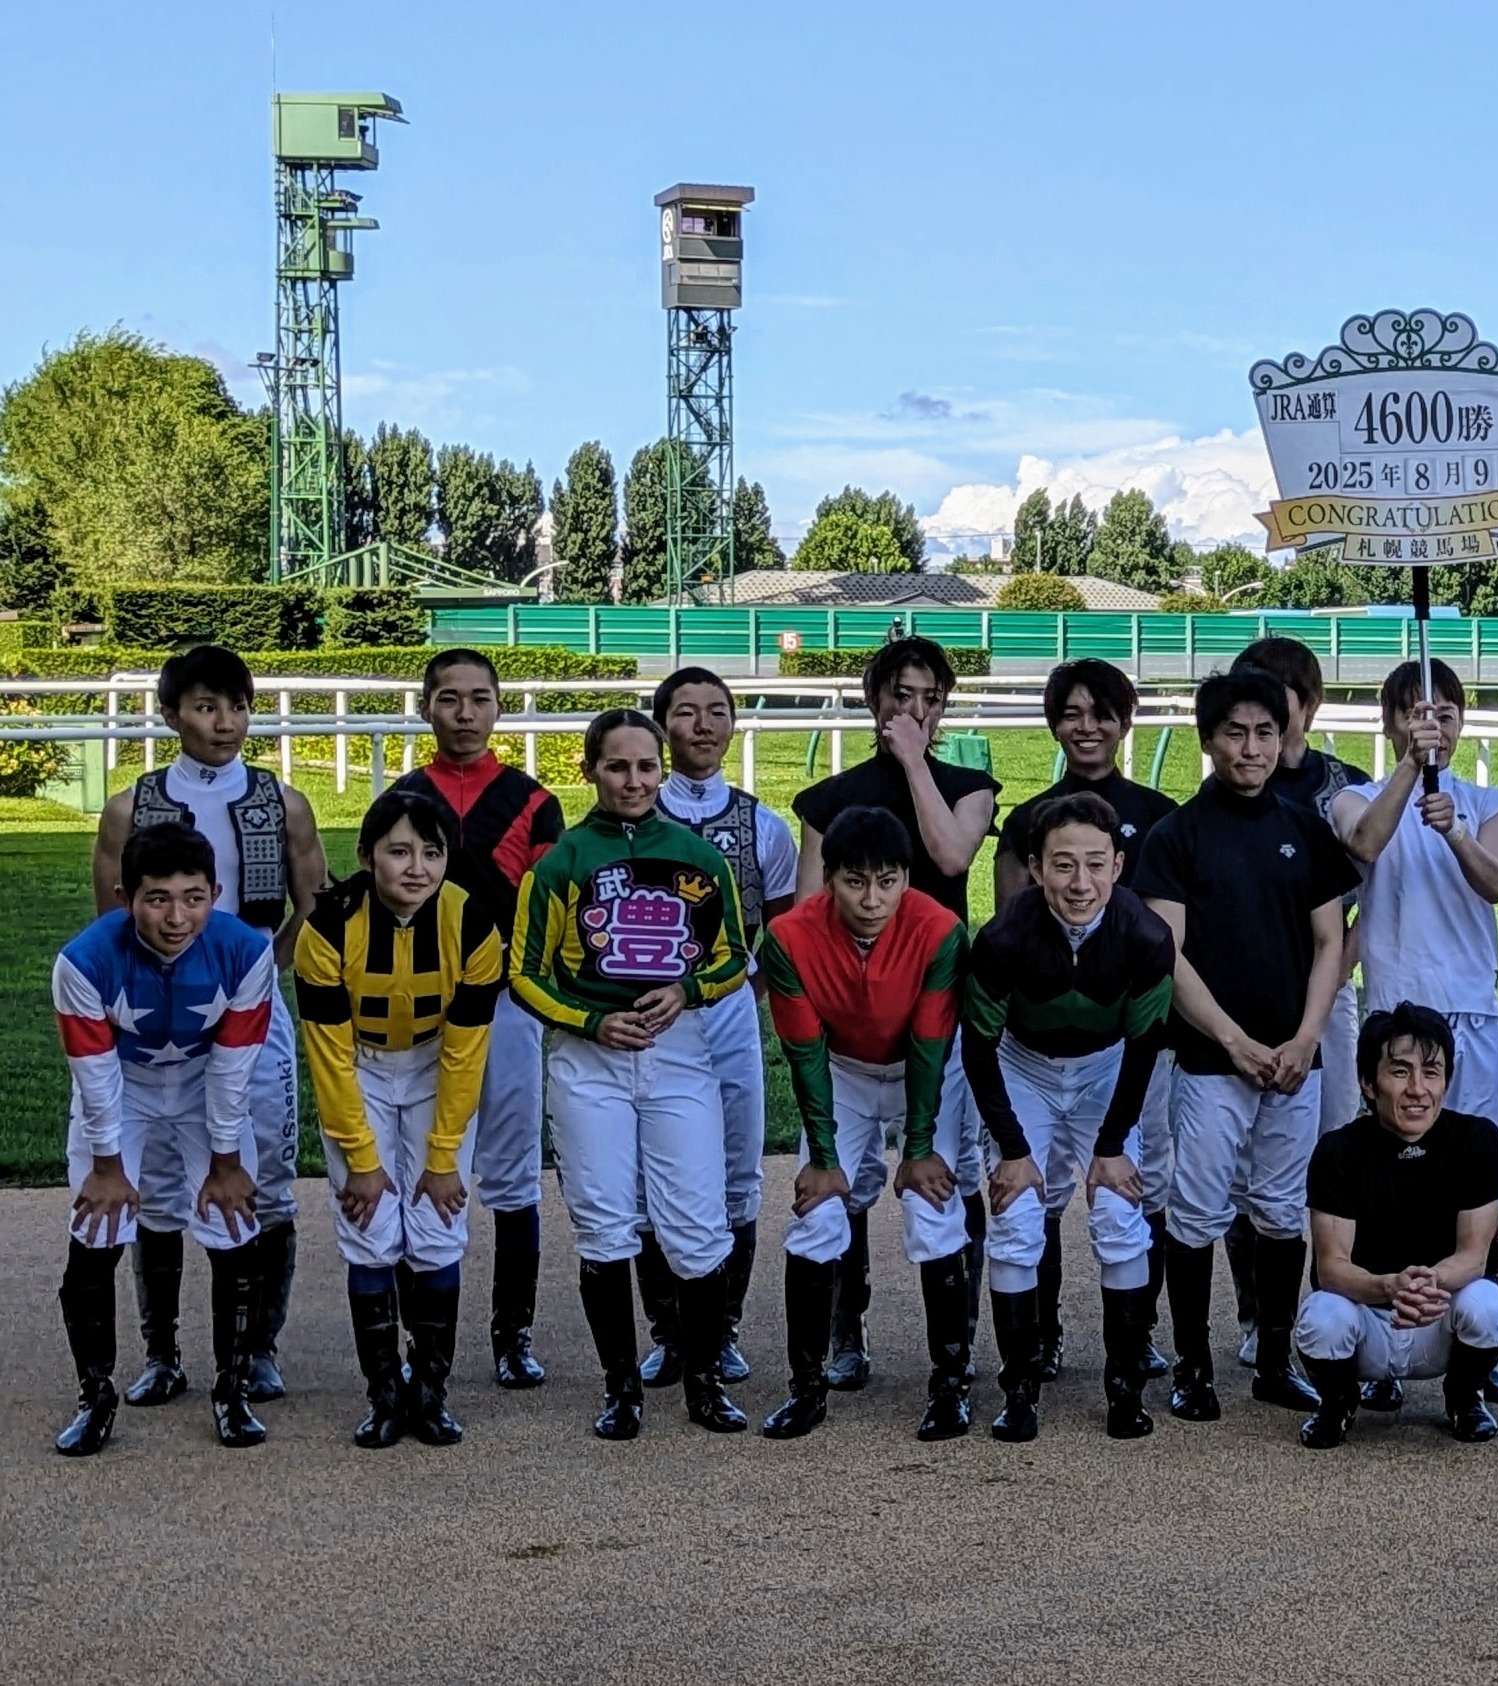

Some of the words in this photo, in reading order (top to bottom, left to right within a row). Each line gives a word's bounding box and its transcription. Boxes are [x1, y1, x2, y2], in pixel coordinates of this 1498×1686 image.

[1271, 391, 1337, 421] JRA通算
[1354, 390, 1494, 445] 4600勝
[1357, 534, 1480, 559] 札幌競馬場
[783, 632, 797, 650] 15
